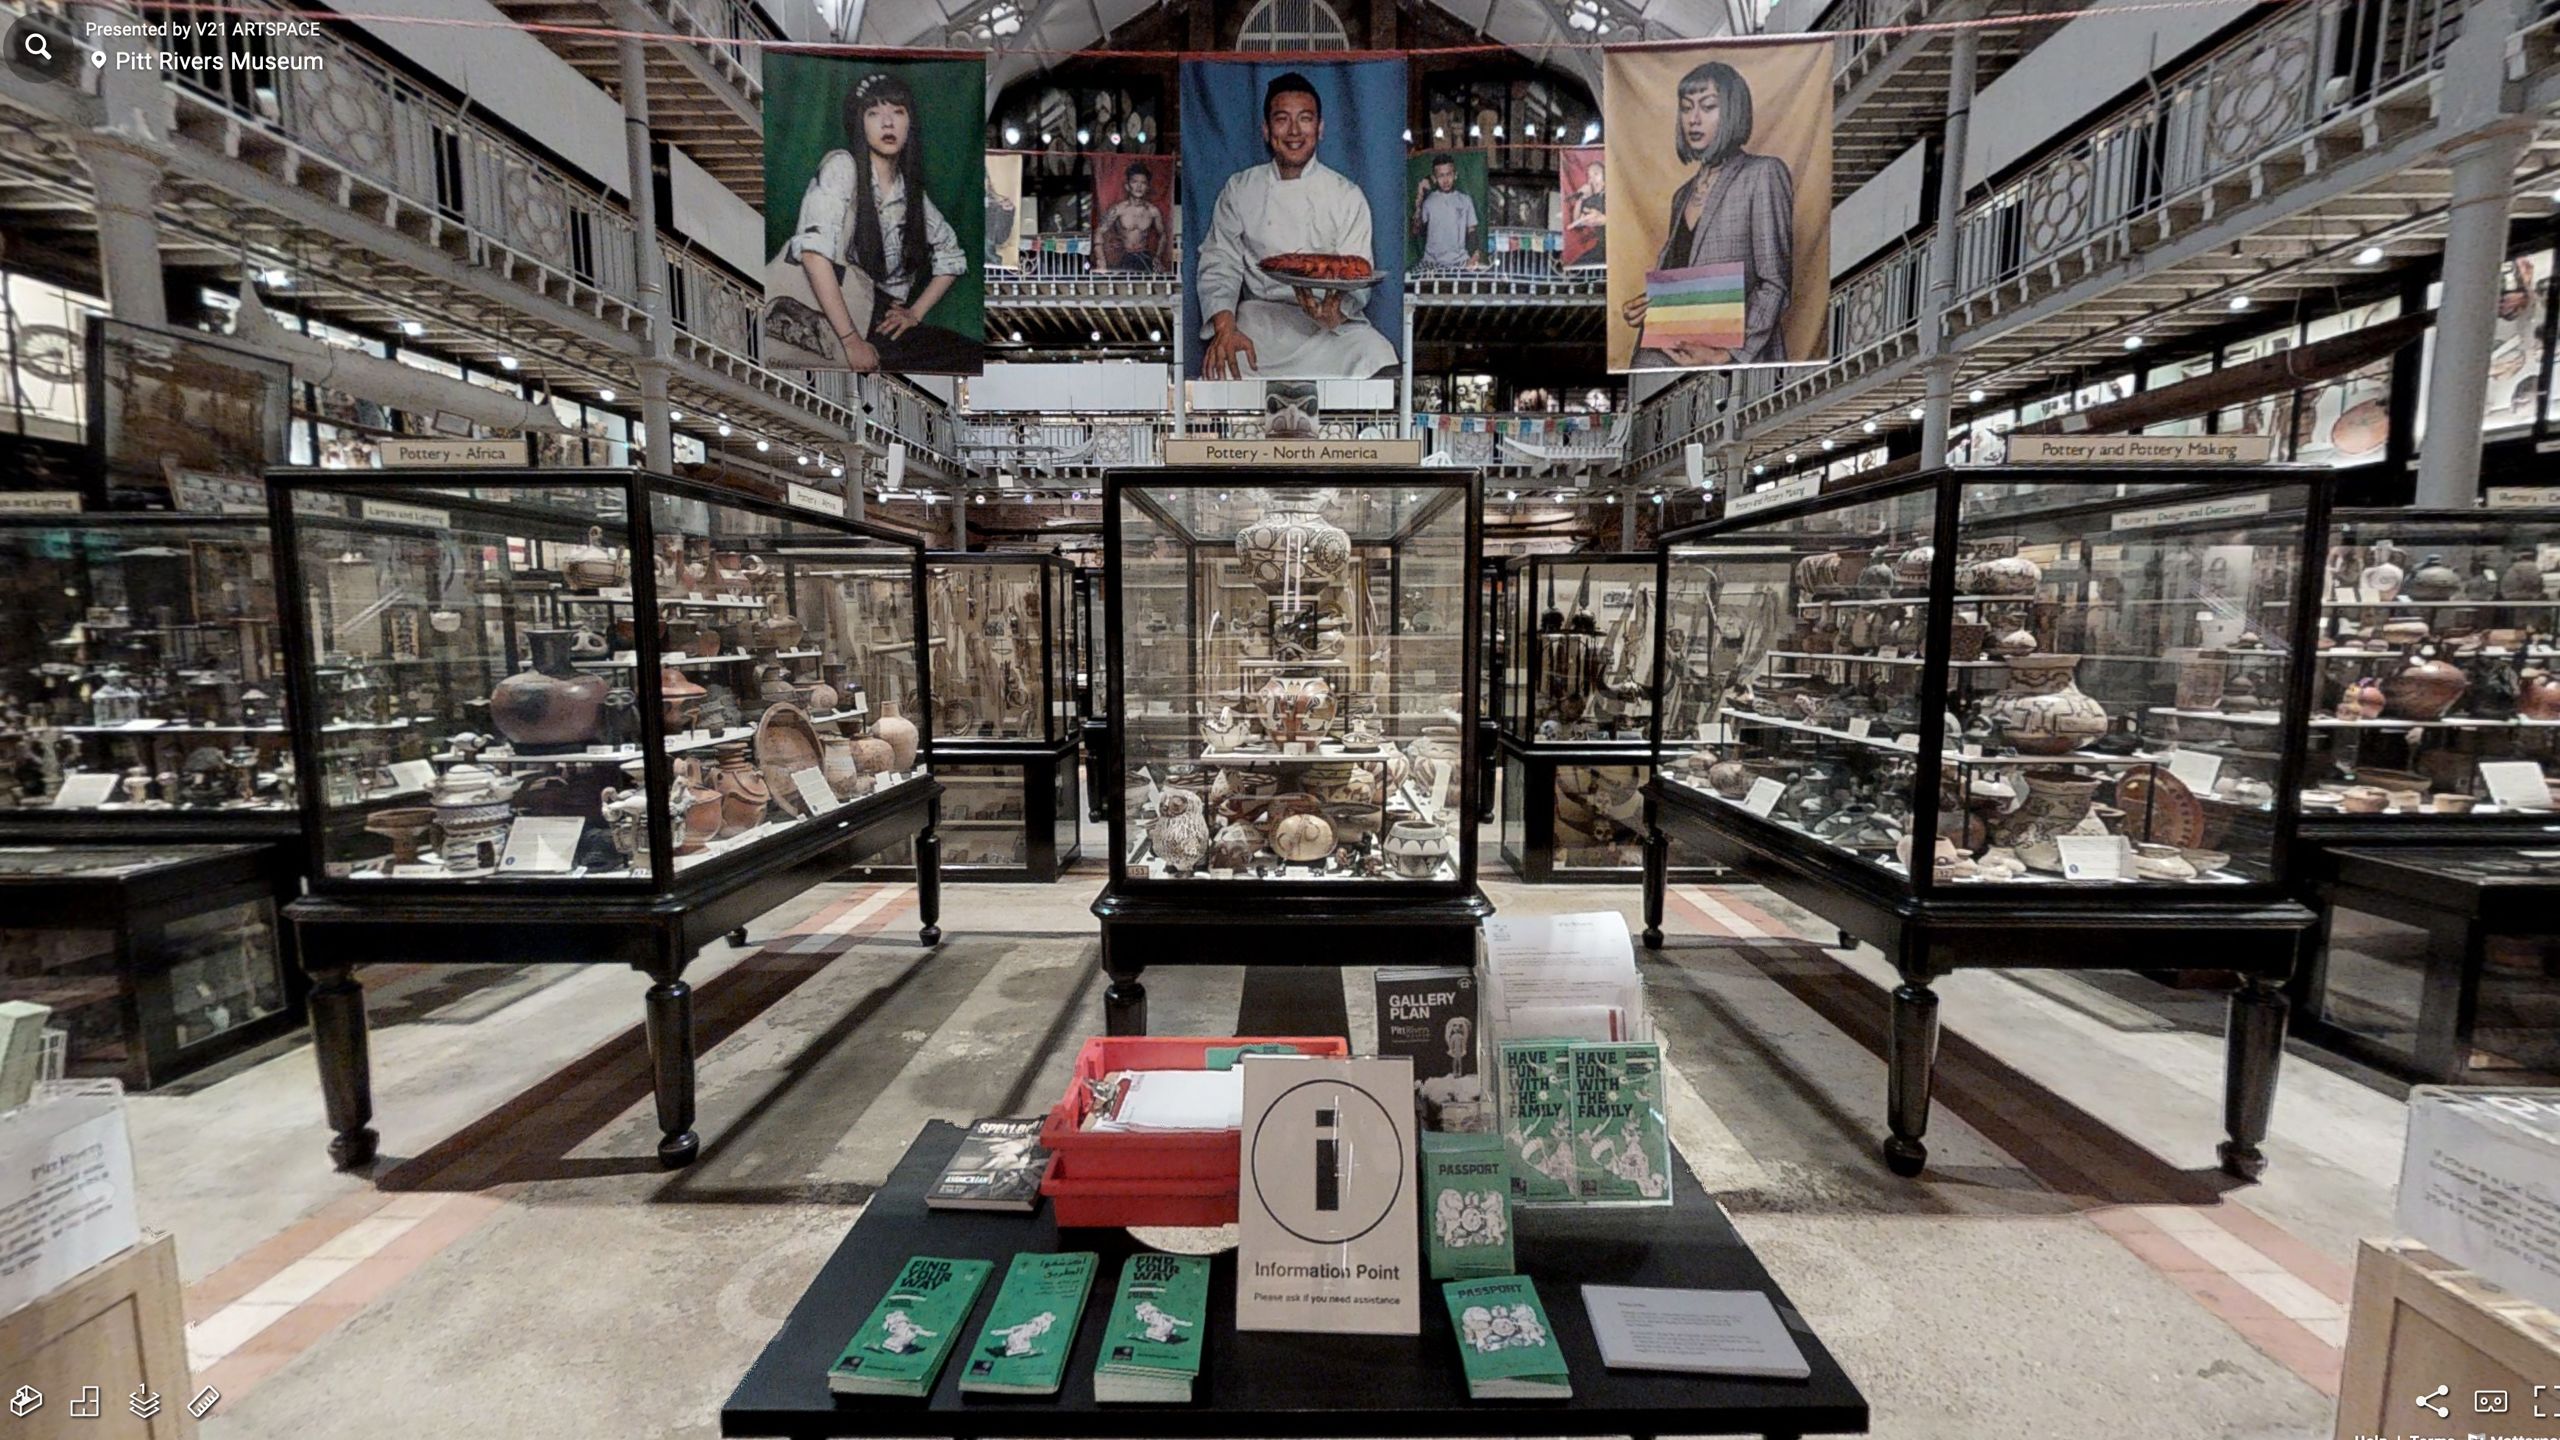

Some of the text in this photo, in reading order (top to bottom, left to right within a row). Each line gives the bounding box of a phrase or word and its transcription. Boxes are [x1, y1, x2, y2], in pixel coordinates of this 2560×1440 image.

[400, 446, 450, 462] Pottery
[467, 446, 506, 460] Africa
[1206, 446, 1258, 462] Pottery
[1273, 446, 1315, 459] North
[1320, 446, 1378, 459] America
[2042, 443, 2238, 460] Pottery and Pottery Making
[1389, 992, 1456, 1007] GALLERY
[1390, 1006, 1430, 1020] PLAN
[1508, 1051, 1548, 1065] HAVE
[1576, 1051, 1618, 1065] HAVE
[1508, 1064, 1537, 1078] FUN
[1576, 1065, 1606, 1078] FUN
[1509, 1078, 1550, 1091] WITH
[1577, 1078, 1620, 1091] WITH
[1509, 1091, 1537, 1104] THE
[1577, 1091, 1607, 1105] THE
[1509, 1104, 1563, 1118] FAMILY
[1578, 1104, 1633, 1118] FAMILY
[1439, 1163, 1500, 1176] PASSPORT
[910, 1260, 952, 1272] FIND
[1135, 1255, 1175, 1266] FIND
[906, 1269, 953, 1282] YOUR
[1135, 1263, 1180, 1275] YOUR
[1255, 1261, 1400, 1280] Information Point
[1133, 1272, 1174, 1282] WAY
[900, 1278, 944, 1291] WAY
[1457, 1284, 1522, 1299] PASSPORT
[1254, 1292, 1400, 1305] Please ask if you need assistance
